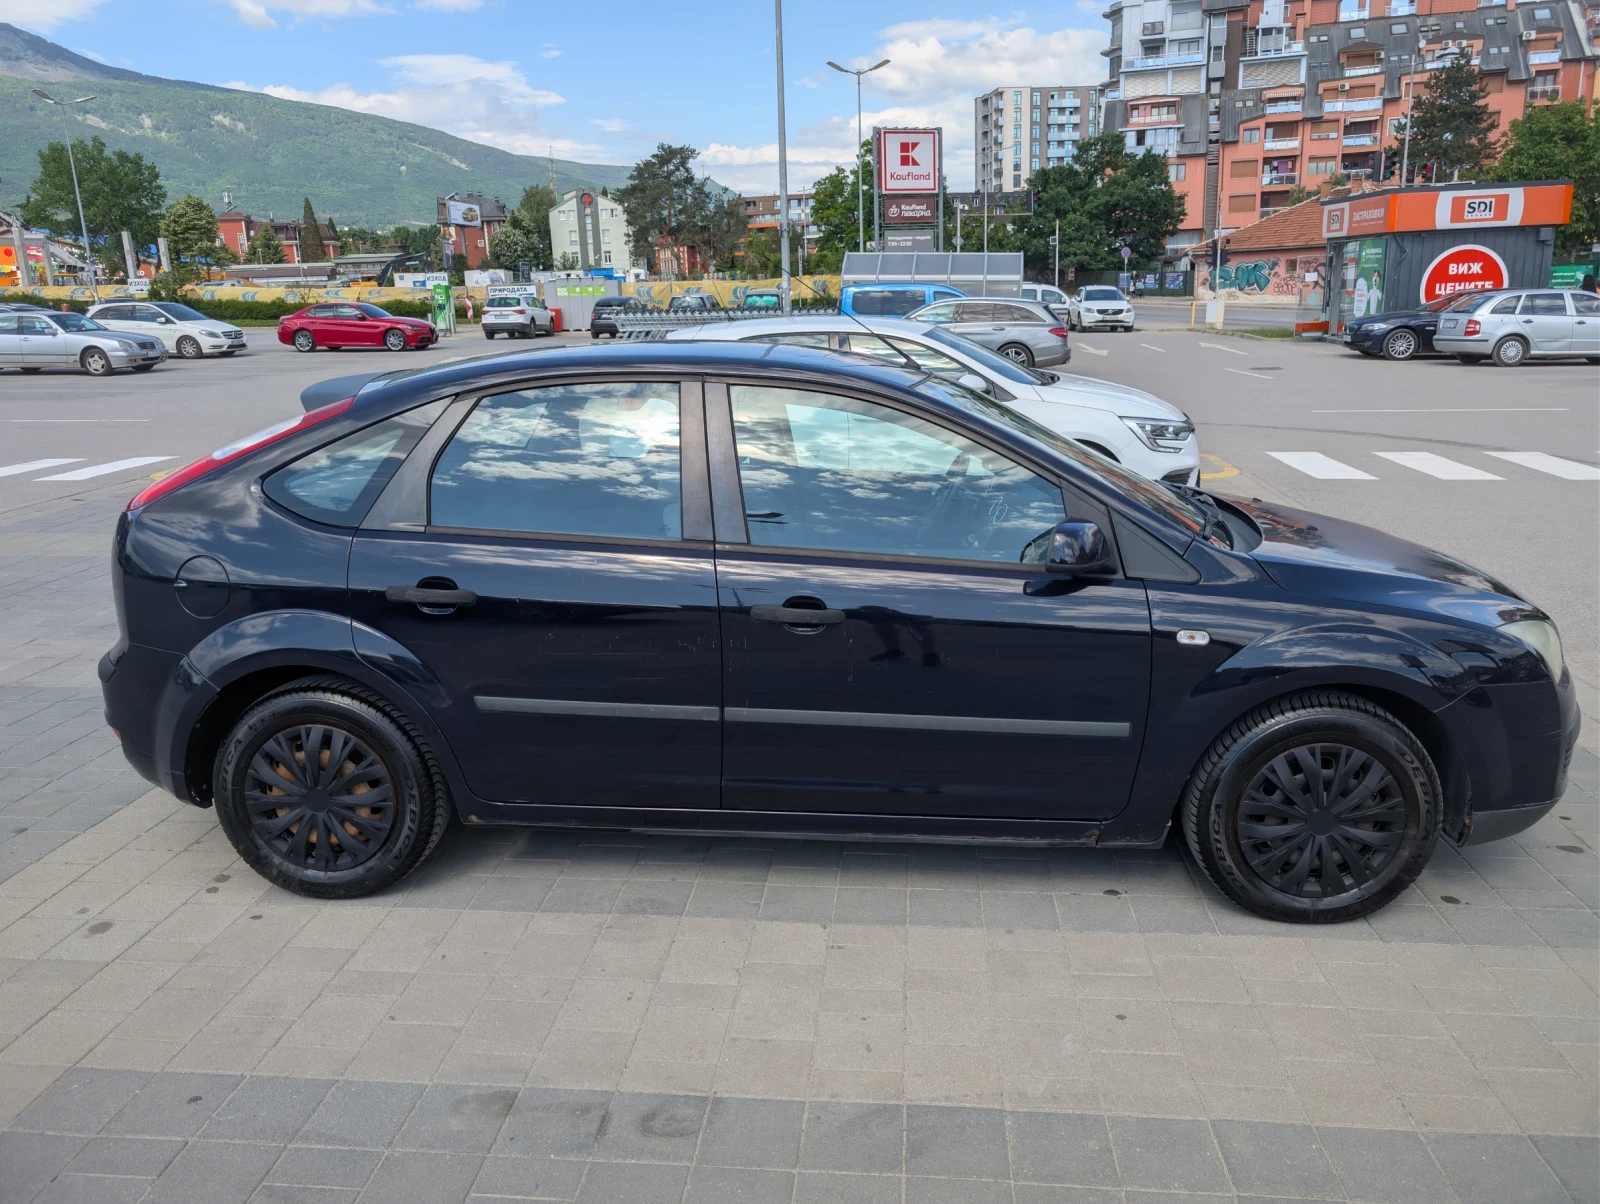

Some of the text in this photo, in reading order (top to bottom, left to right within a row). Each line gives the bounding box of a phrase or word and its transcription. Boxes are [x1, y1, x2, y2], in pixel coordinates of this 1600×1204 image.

[890, 171, 931, 181] Kaufland
[1466, 200, 1494, 214] SDI
[901, 210, 932, 218] пекарна
[1331, 213, 1340, 226] SDI
[1352, 208, 1385, 221] ЗАСТРАХОВКИ
[1448, 262, 1484, 275] ВИЖ
[1435, 280, 1494, 295] ЦЕНИТЕ
